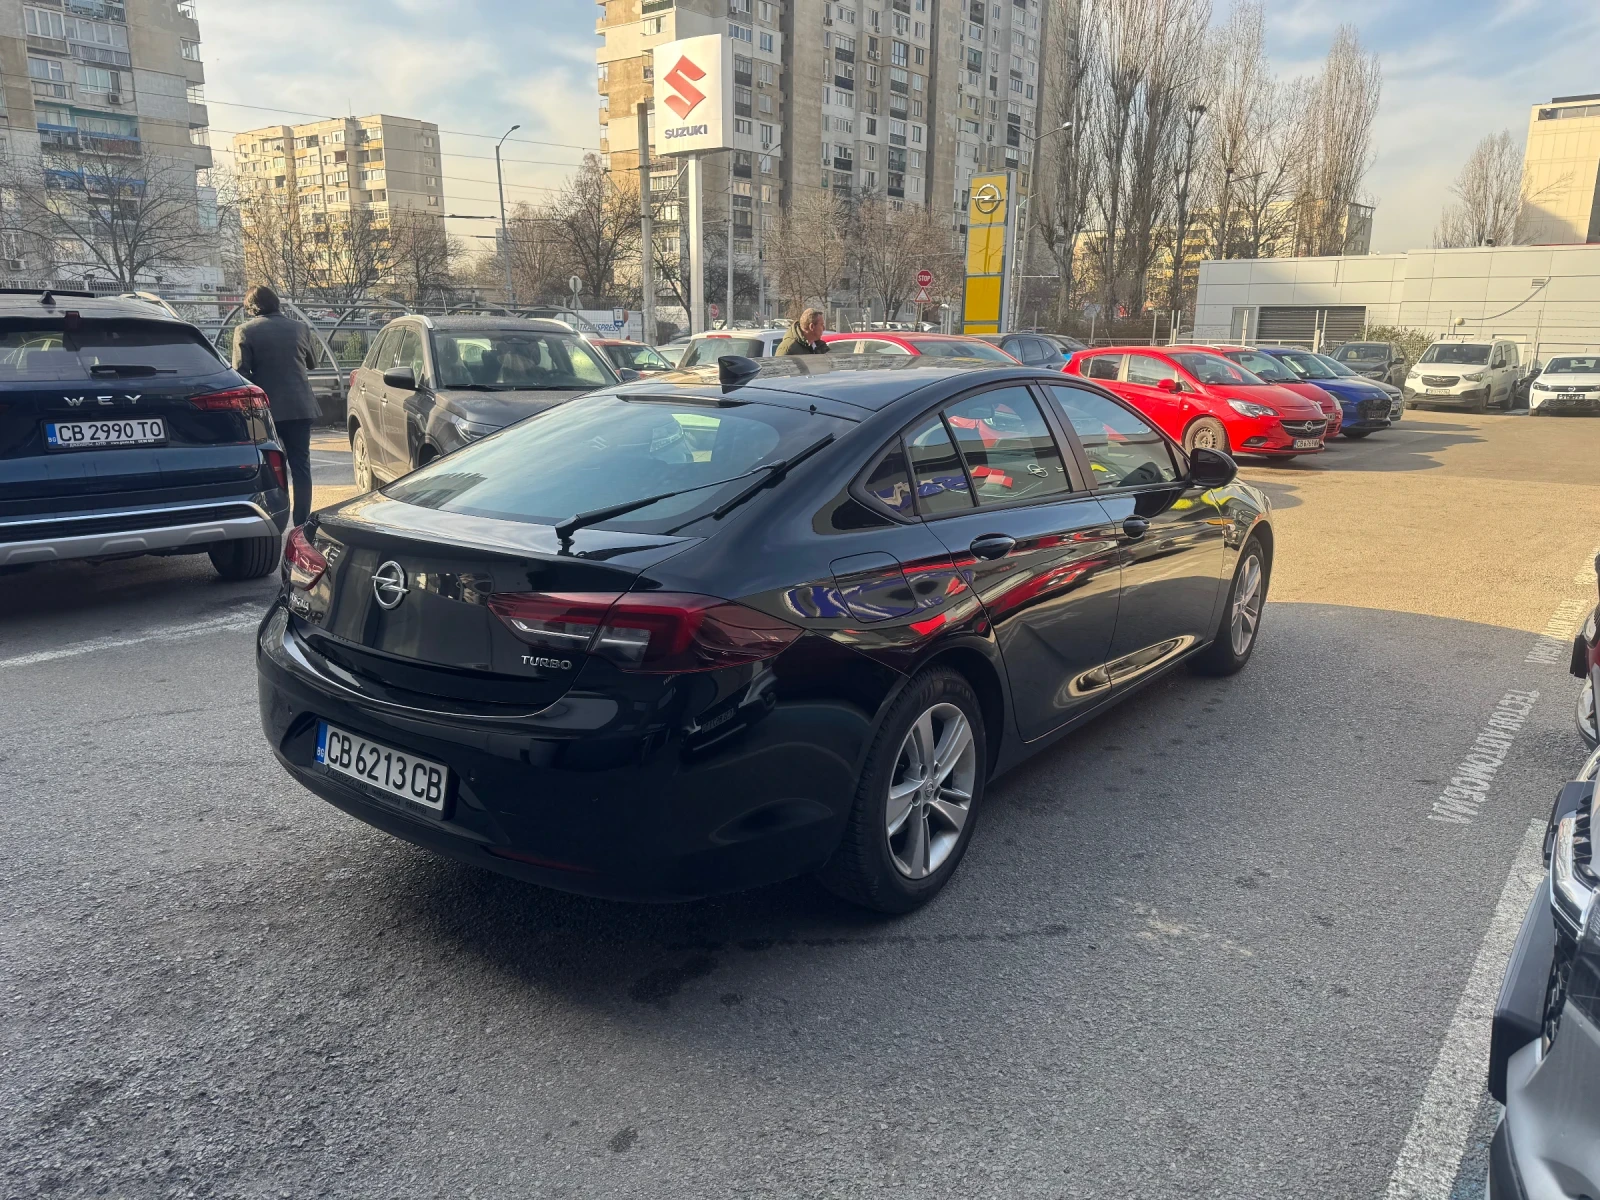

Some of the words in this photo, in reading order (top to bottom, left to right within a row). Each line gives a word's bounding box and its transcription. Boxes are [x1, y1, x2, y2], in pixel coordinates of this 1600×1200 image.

[664, 124, 708, 139] SUZUKI
[918, 274, 931, 282] STOP
[63, 395, 142, 406] WEY
[58, 424, 85, 442] CB
[88, 422, 134, 440] 2990
[137, 421, 162, 438] TO
[521, 655, 572, 670] TURBO
[355, 742, 407, 790] 6213
